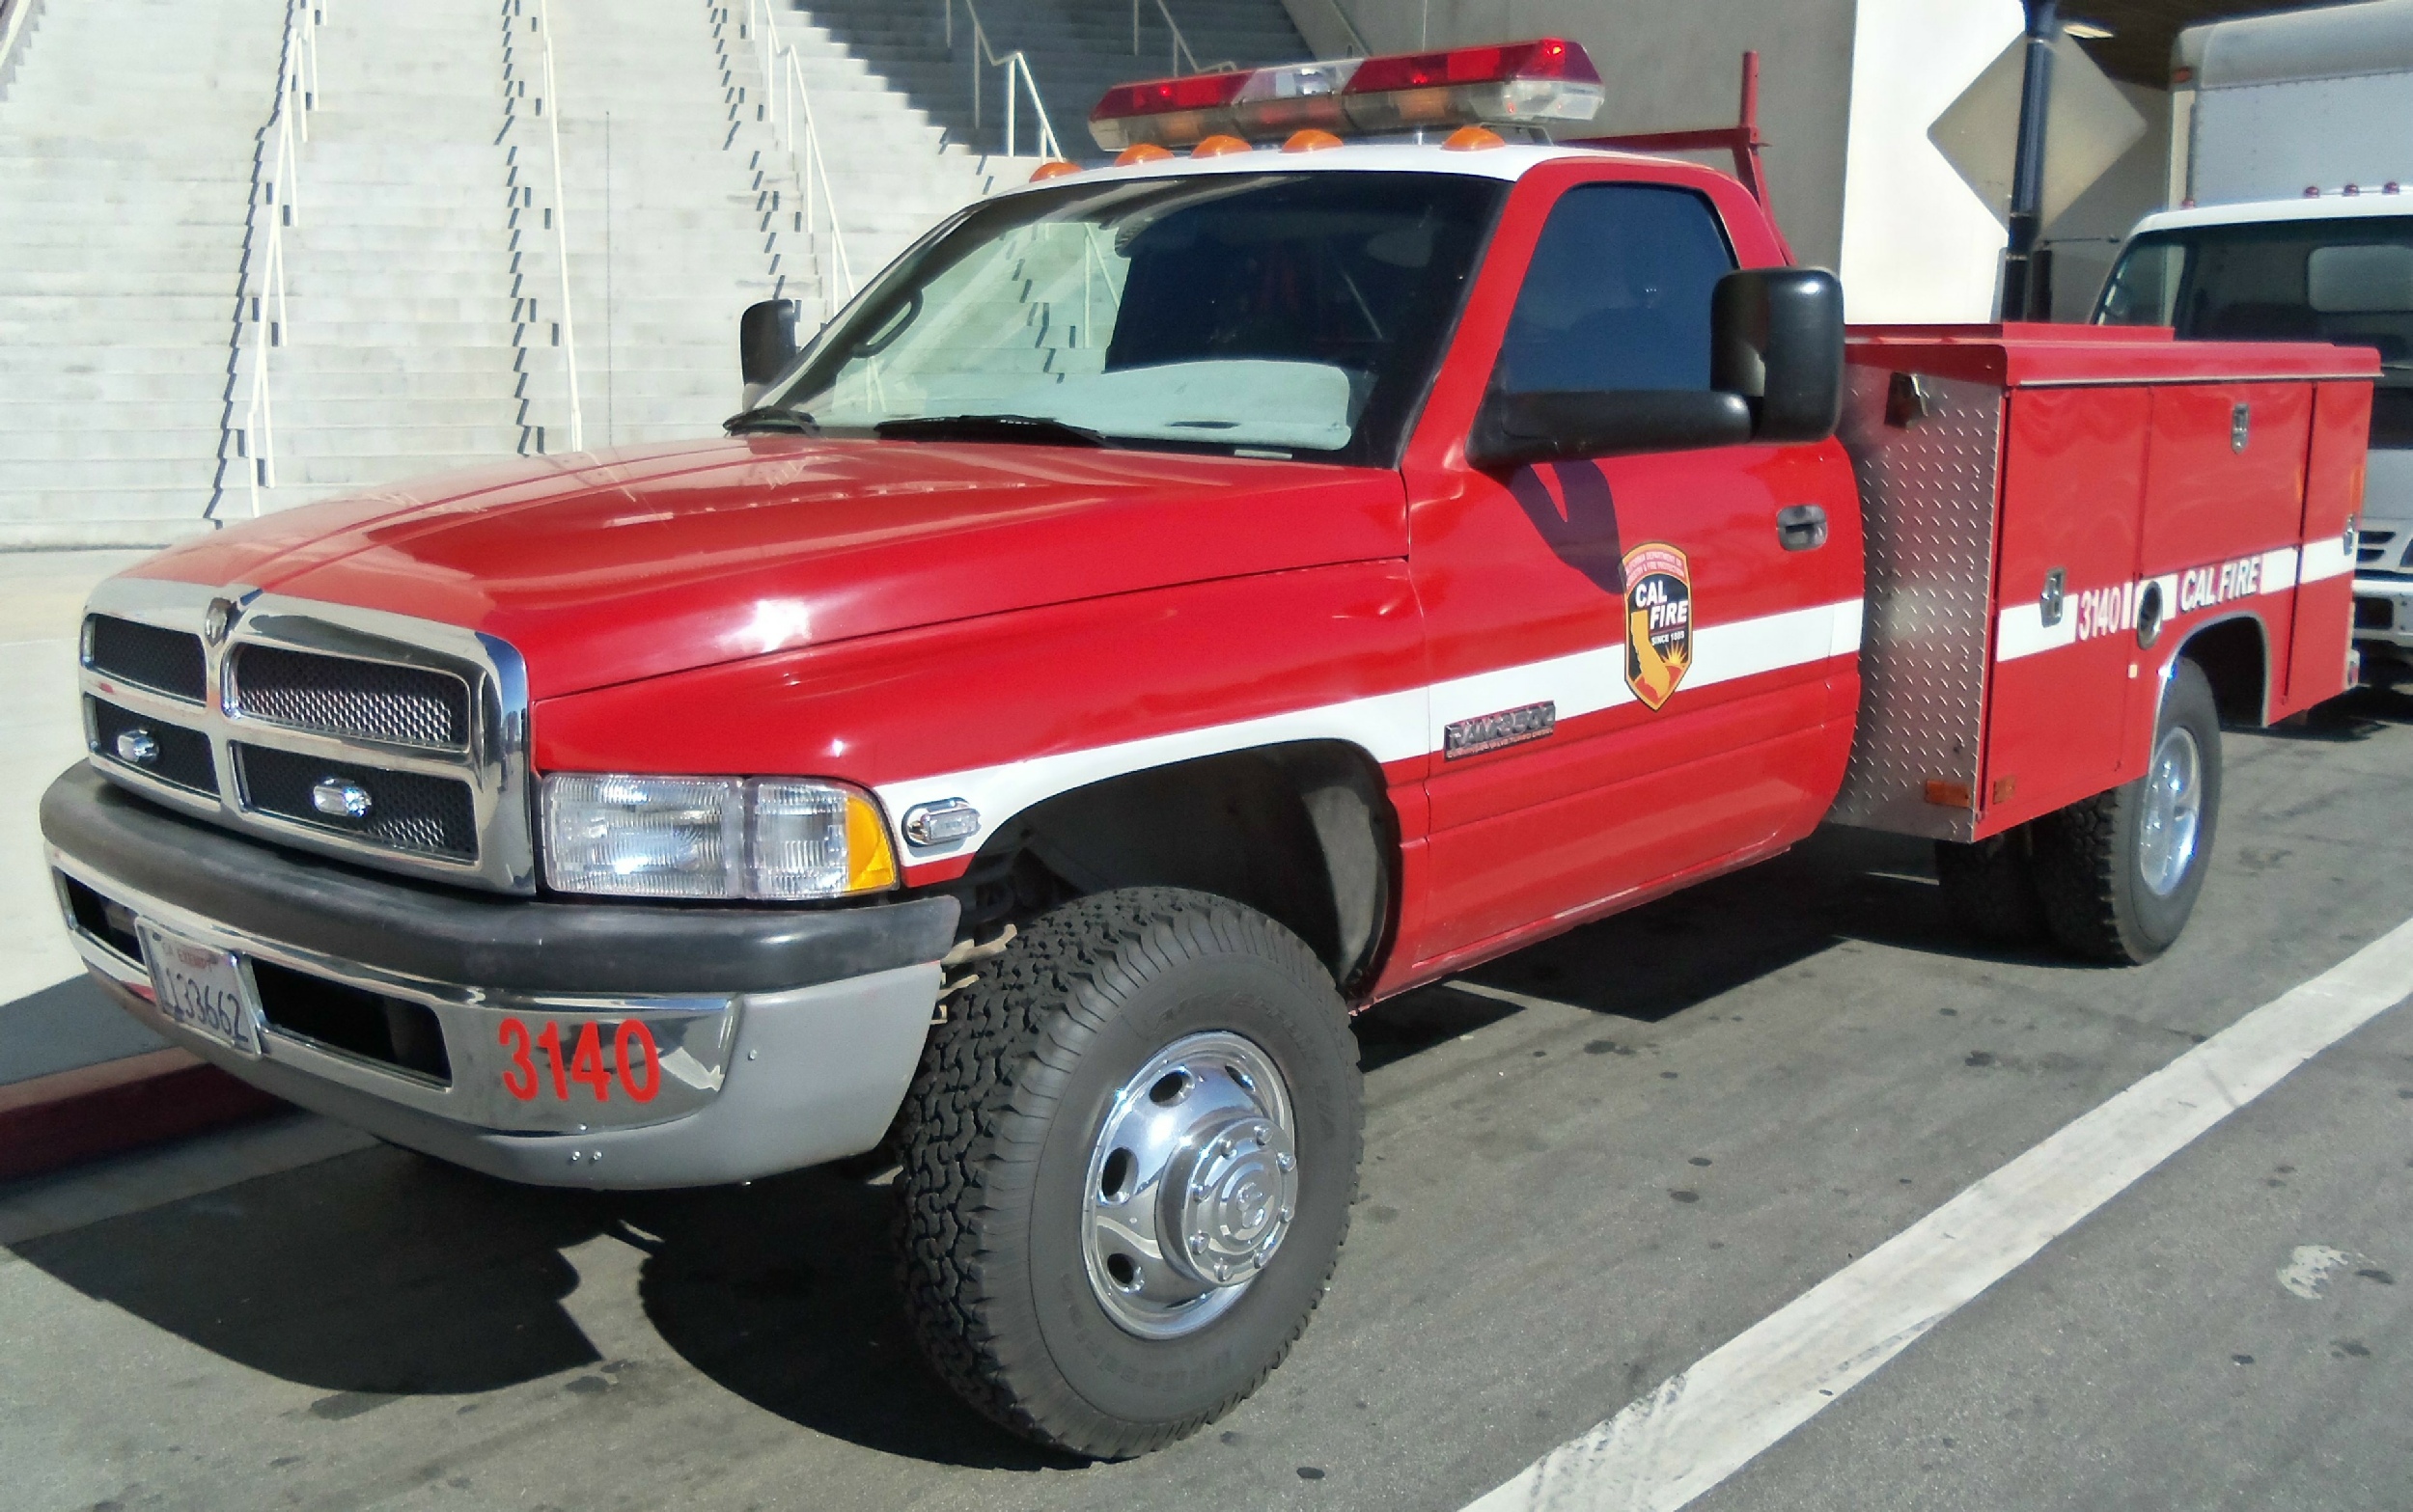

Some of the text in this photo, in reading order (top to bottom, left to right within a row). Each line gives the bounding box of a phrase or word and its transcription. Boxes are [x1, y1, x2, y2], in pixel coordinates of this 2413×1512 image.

[1635, 580, 1667, 609] CAL
[2078, 557, 2261, 642] 3140 CAL FIRE
[1650, 599, 1689, 630] FIRE
[1651, 633, 1670, 646] SINCE
[498, 1016, 661, 1104] 3140
